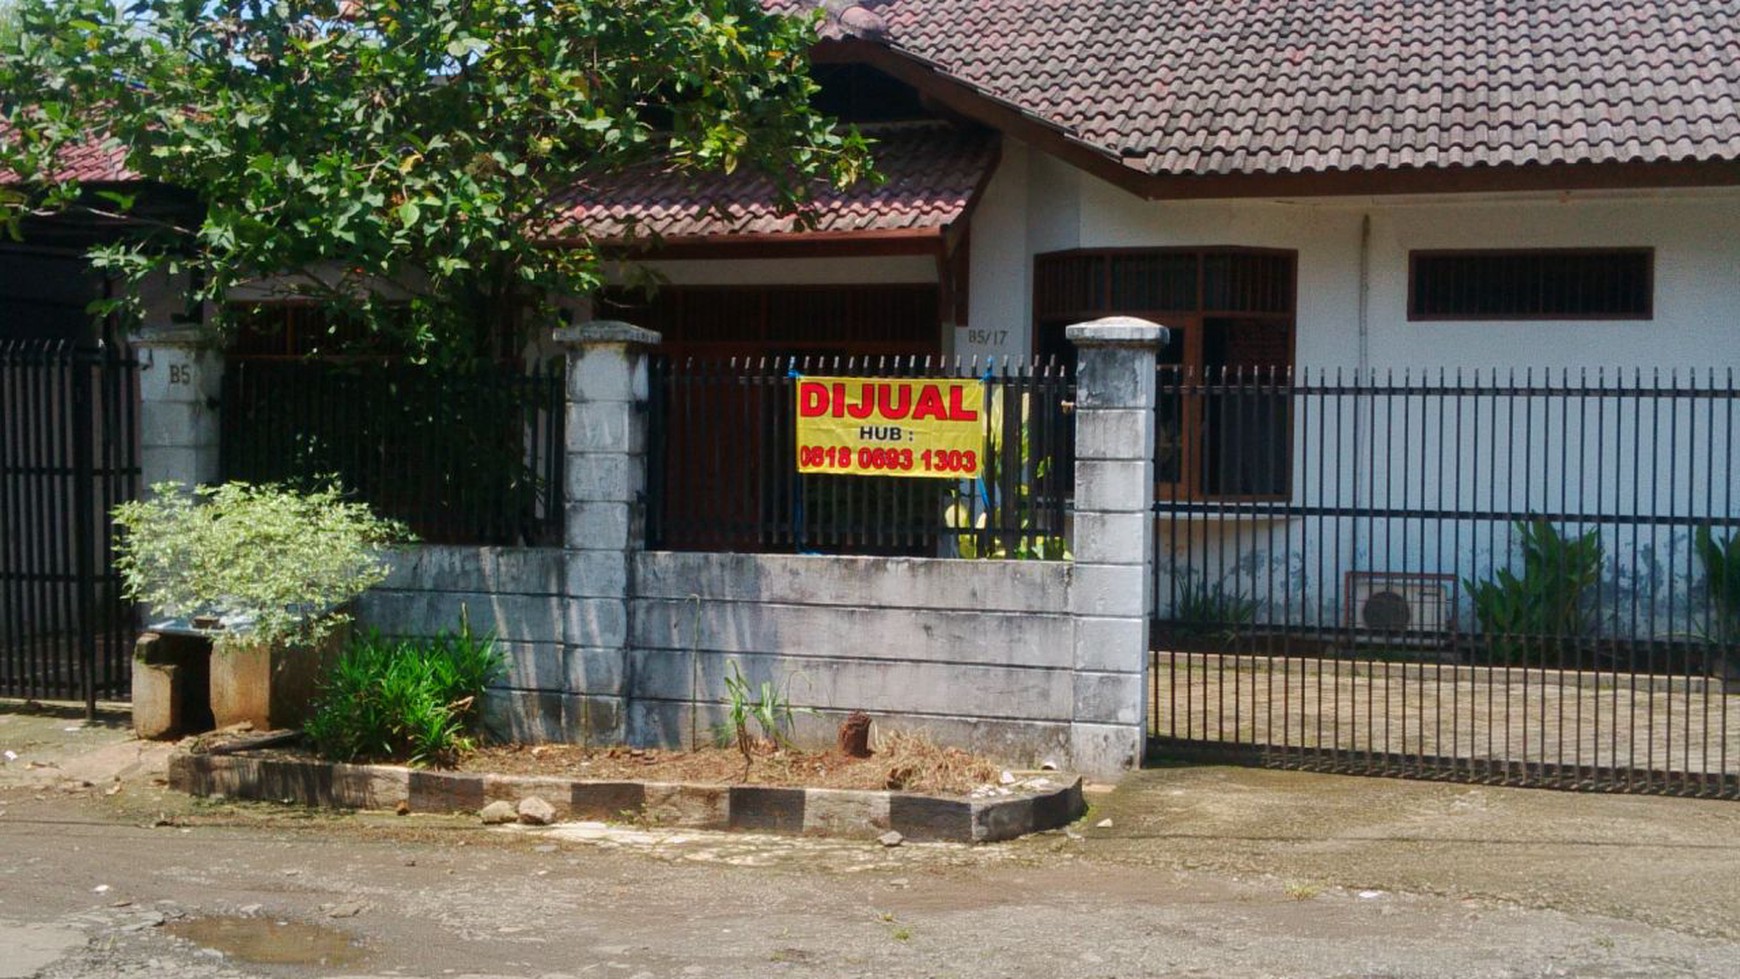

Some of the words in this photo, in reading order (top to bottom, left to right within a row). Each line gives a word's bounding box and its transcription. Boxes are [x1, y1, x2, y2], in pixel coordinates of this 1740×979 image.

[968, 329, 1008, 346] B5/17
[170, 365, 191, 385] B5
[800, 382, 978, 421] DIJUAL
[859, 426, 902, 441] HUB
[800, 446, 852, 469] 0818
[858, 447, 914, 471] 0693
[921, 449, 977, 472] 1303
